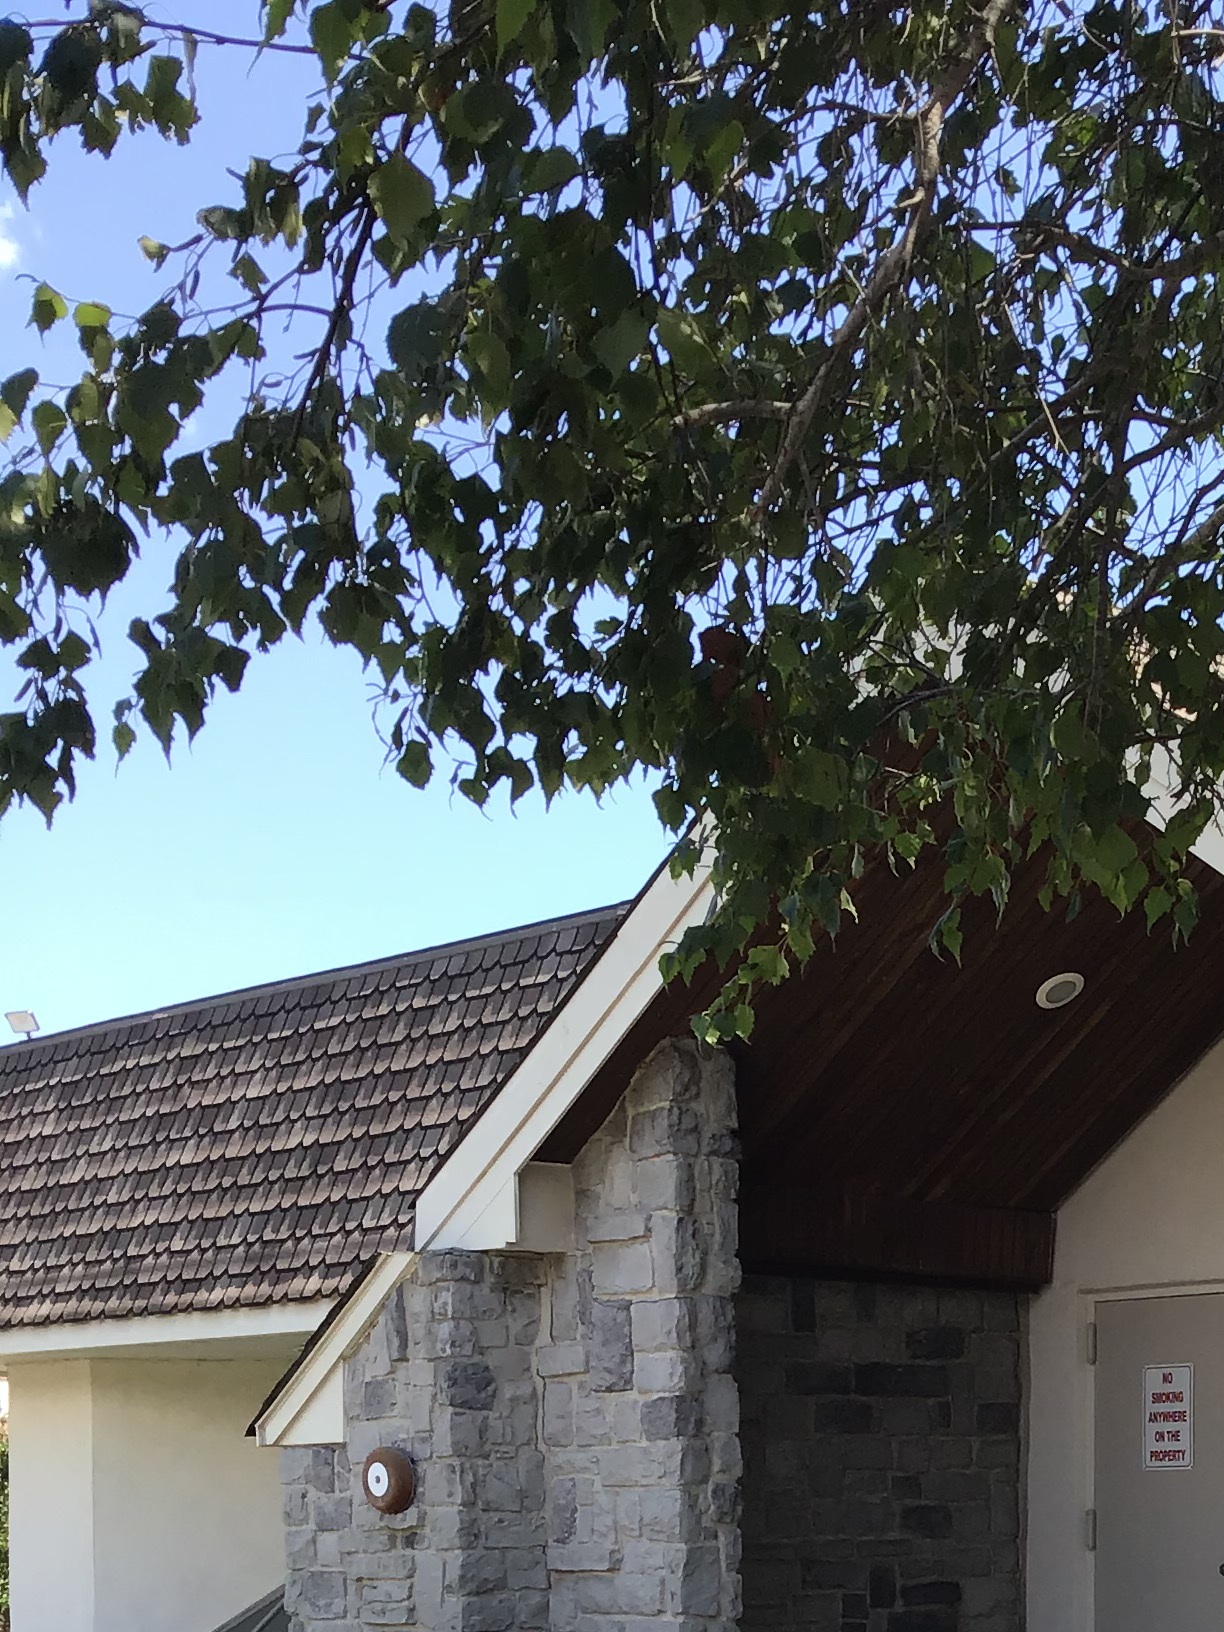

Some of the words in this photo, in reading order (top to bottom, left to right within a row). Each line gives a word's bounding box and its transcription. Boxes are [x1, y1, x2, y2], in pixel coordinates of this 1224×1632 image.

[1162, 1373, 1173, 1384] NO
[1152, 1391, 1184, 1404] SMOKING
[1148, 1410, 1187, 1423] ANYWHERE
[1154, 1431, 1165, 1442] ON
[1166, 1430, 1180, 1442] THE
[1150, 1449, 1186, 1462] PROPERTY
